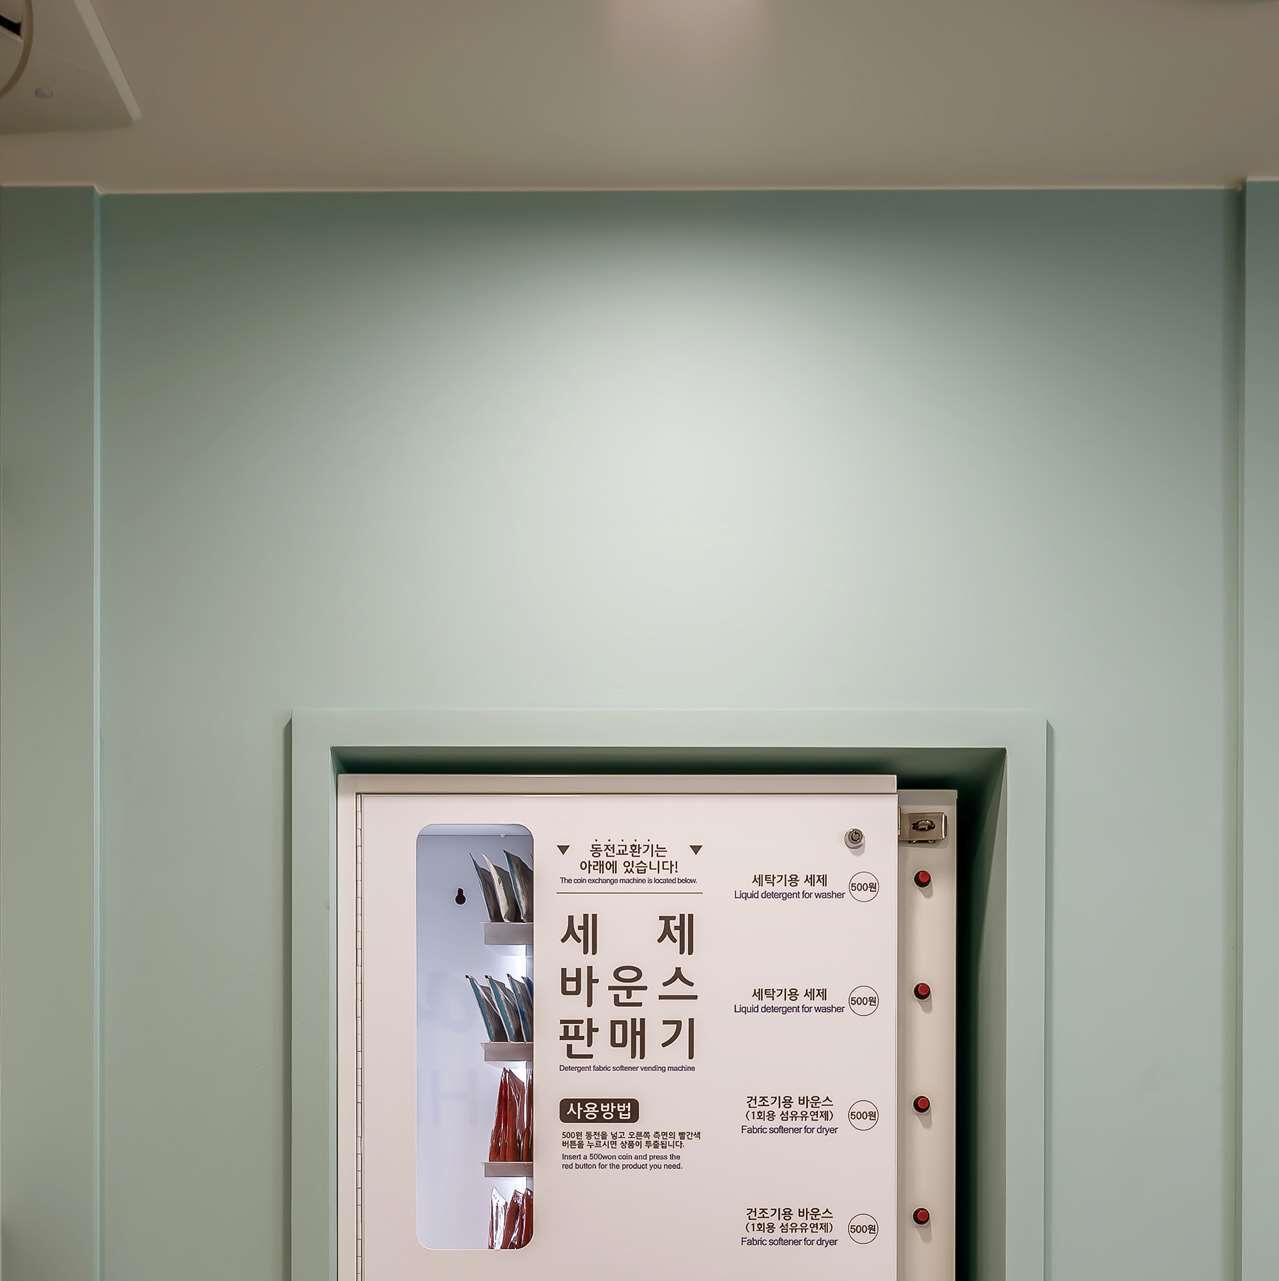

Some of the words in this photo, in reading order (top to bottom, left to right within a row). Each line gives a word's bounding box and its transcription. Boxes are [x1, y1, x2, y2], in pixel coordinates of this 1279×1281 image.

[589, 843, 668, 859] 동전교환기는
[579, 859, 618, 875] 아래에
[622, 860, 679, 875] 있습니다!
[559, 876, 573, 884] The
[573, 876, 587, 884] coin
[587, 877, 619, 886] exchange
[653, 876, 677, 884] located
[751, 873, 800, 888] 세탁기용
[803, 873, 828, 887] 세제
[850, 881, 878, 894] 500원
[734, 889, 760, 901] Liquid
[760, 890, 801, 902] detergent
[801, 889, 814, 899] for
[814, 890, 846, 900] washer
[751, 987, 800, 1002] 세탁기용
[803, 987, 827, 1002] 세제
[849, 995, 878, 1008] 500원
[733, 1003, 760, 1016] Liquid
[760, 1004, 801, 1016] detergent
[801, 1003, 814, 1014] for
[813, 1004, 846, 1014] washer
[559, 1064, 592, 1073] Detergent
[592, 1064, 612, 1072] fabric
[611, 1064, 640, 1072] softener
[639, 1064, 667, 1073] vending
[666, 1064, 696, 1072] machine
[746, 1095, 794, 1109] 건조기용
[798, 1095, 834, 1109] 바운스
[567, 1103, 630, 1119] 사용방법
[745, 1109, 777, 1122] (1회용
[779, 1110, 834, 1122] 섬유유연제)
[849, 1109, 878, 1123] 500원
[741, 1124, 768, 1135] Fabric
[768, 1124, 803, 1135] softener
[803, 1124, 816, 1135] for
[816, 1125, 839, 1136] dryer
[561, 1153, 582, 1161] Insert
[589, 1152, 617, 1161] 500won
[633, 1153, 648, 1161] and
[648, 1154, 669, 1162] press
[669, 1153, 681, 1161] the
[561, 1162, 574, 1170] red
[574, 1162, 597, 1170] button
[597, 1162, 608, 1170] for
[608, 1162, 621, 1170] the
[621, 1162, 648, 1171] product
[648, 1163, 663, 1172] you
[663, 1162, 683, 1170] need.
[746, 1207, 794, 1222] 건조기용
[797, 1207, 834, 1221] 바운스
[745, 1222, 776, 1234] (1회용
[779, 1222, 834, 1234] 섬유유연제)
[849, 1222, 878, 1236] 500원
[740, 1236, 768, 1247] Fabric
[768, 1236, 803, 1247] softener
[803, 1236, 816, 1247] for
[815, 1237, 839, 1249] dryer
